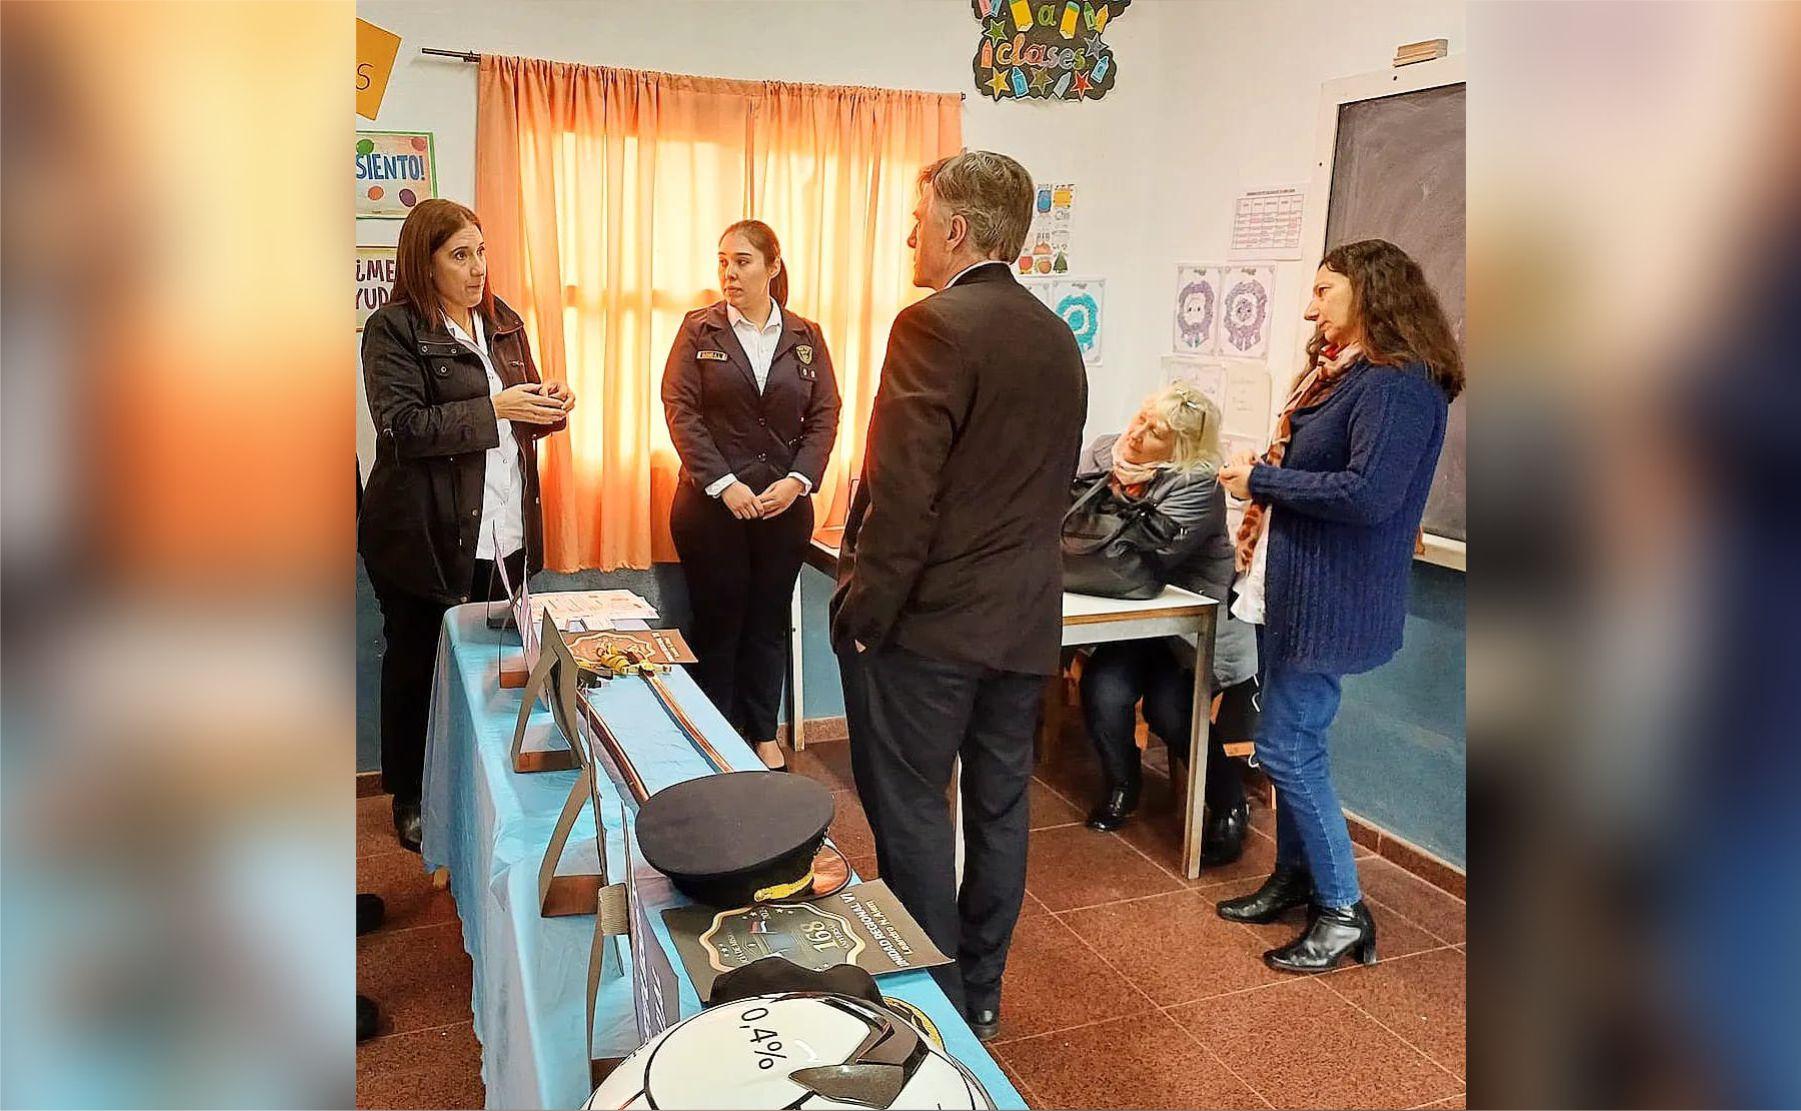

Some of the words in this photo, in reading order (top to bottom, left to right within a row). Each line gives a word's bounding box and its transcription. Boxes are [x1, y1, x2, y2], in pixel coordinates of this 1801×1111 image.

[1037, 4, 1057, 27] a
[996, 33, 1086, 70] clases
[356, 63, 374, 90] S
[356, 153, 425, 181] SIENTO!
[840, 892, 856, 904] VI
[851, 902, 887, 940] REGIONAL
[800, 920, 840, 953] 168
[886, 925, 914, 955] Leandro
[739, 1007, 787, 1070] 0,4%
